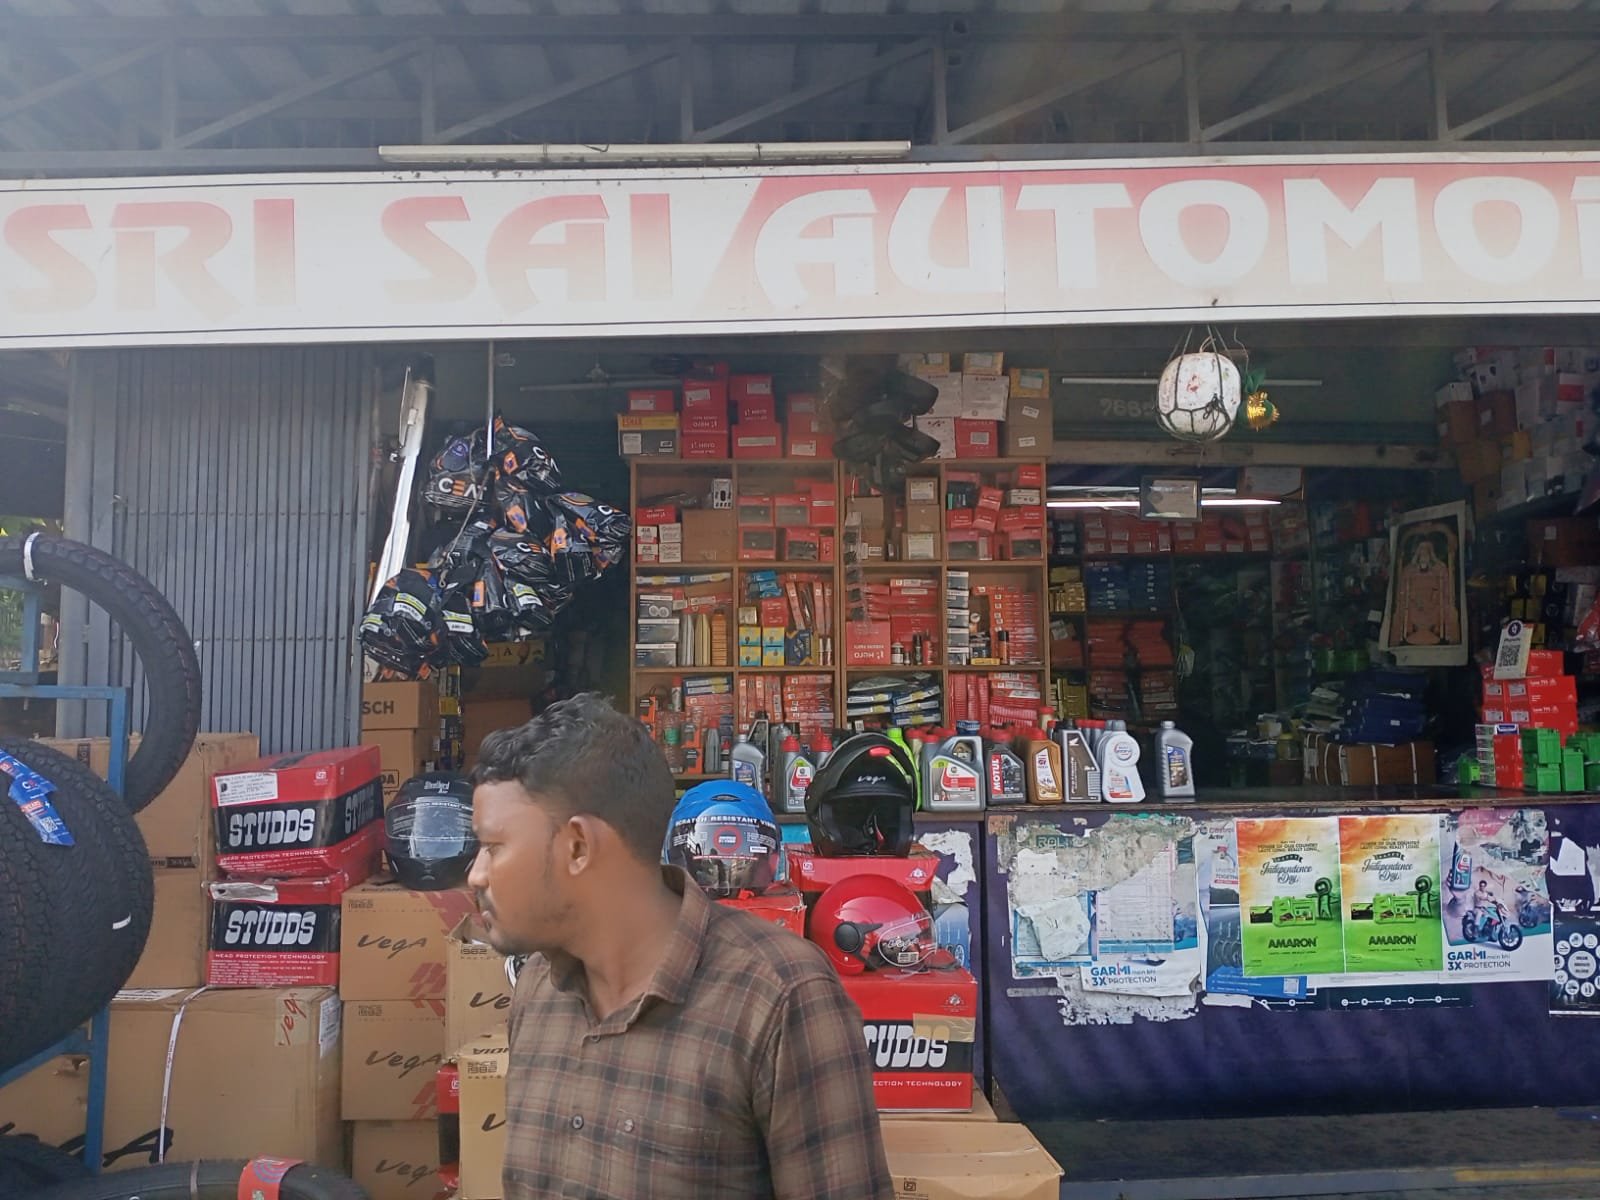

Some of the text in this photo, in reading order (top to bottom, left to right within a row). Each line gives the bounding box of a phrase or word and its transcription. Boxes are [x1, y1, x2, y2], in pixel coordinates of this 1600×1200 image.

[2, 174, 1600, 320] SRI SAI AUTOMO
[992, 758, 1001, 791] MOTUL
[710, 815, 758, 824] RESISTANT
[229, 807, 316, 848] STUDDS
[240, 852, 281, 860] PROTECTION
[281, 849, 329, 858] TECHNOLOGY
[1260, 861, 1313, 877] Independence
[1361, 859, 1413, 873] Independence
[225, 910, 317, 945] STUDDS
[1267, 938, 1317, 949] AMARON
[1368, 935, 1417, 946] AMARON
[1447, 960, 1511, 971] 3X PROTECTION
[1091, 975, 1157, 986] 3X PROTECTION
[375, 1159, 438, 1188] Veg
